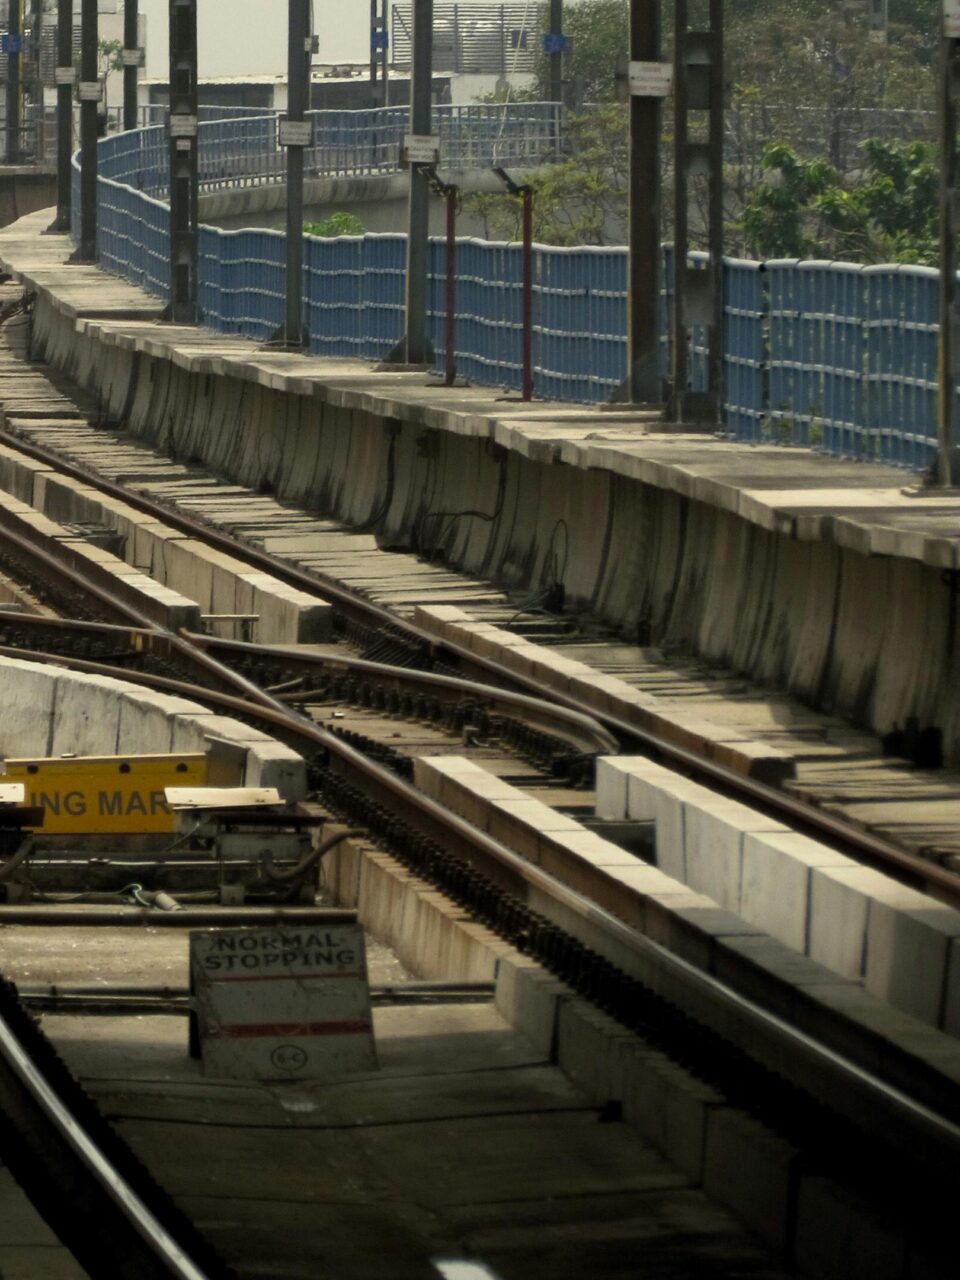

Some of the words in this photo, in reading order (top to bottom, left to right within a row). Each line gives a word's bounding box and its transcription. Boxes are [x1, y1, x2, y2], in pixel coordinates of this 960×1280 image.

[98, 790, 173, 816] MAR
[214, 932, 340, 952] NORMAL
[205, 949, 355, 970] STOPPING
